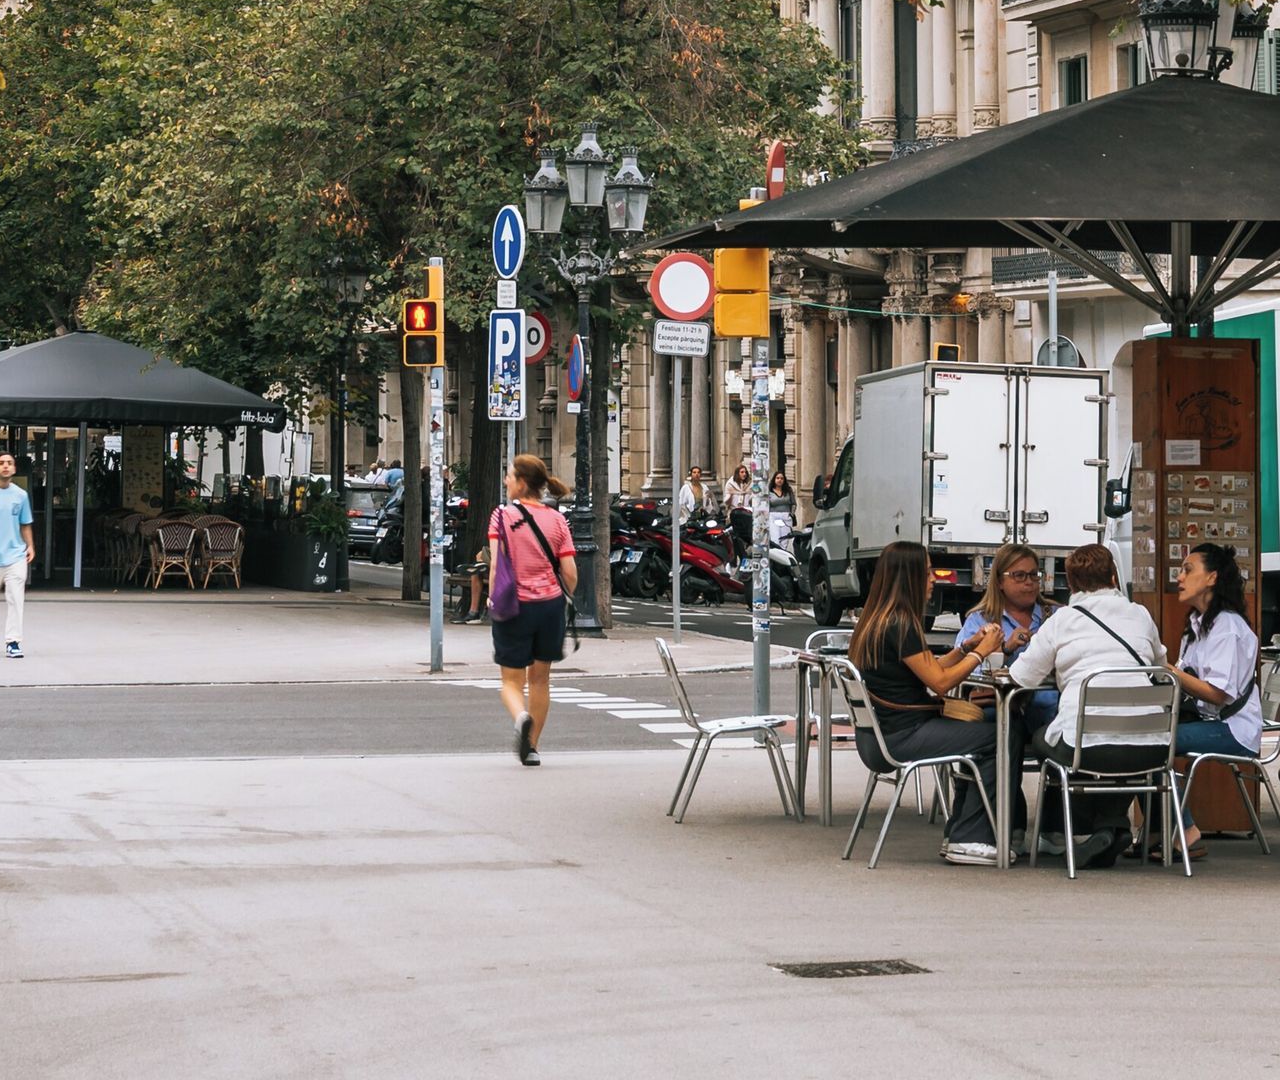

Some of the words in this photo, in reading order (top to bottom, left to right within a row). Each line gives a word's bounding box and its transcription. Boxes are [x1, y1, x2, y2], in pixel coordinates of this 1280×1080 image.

[528, 327, 540, 345] 0
[496, 318, 516, 374] P
[241, 411, 274, 424] fritz-kola
